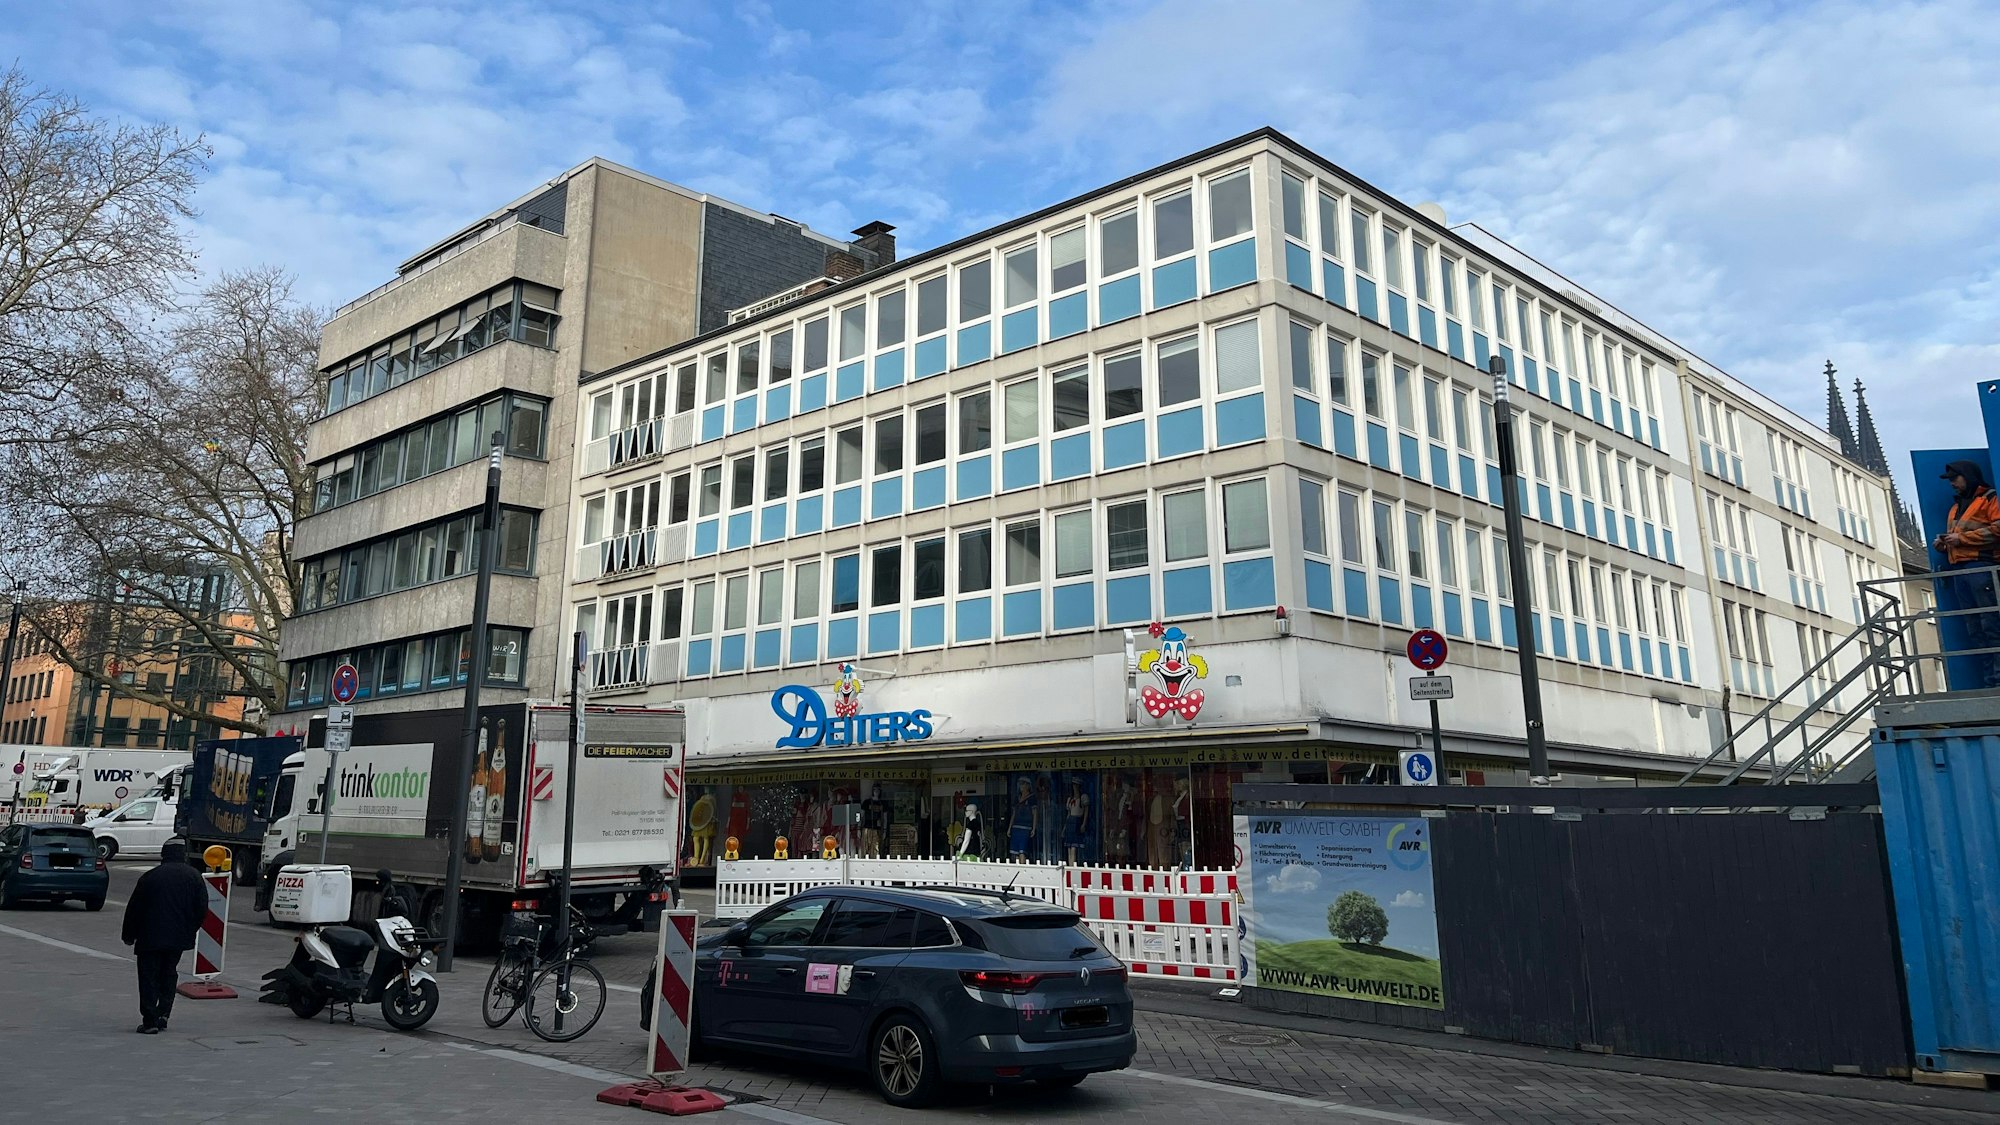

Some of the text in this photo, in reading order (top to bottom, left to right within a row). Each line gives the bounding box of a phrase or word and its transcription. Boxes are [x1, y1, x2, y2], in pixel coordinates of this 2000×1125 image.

[509, 641, 518, 655] 2
[300, 671, 307, 691] 2
[1413, 688, 1451, 696] Seitenstreifen
[587, 746, 670, 756] DIE FEIERMACHER
[1012, 756, 1127, 770] www.deiters.de
[94, 769, 134, 782] WDR
[1254, 821, 1381, 837] AVR UMWELT GMBH
[1321, 845, 1372, 854] Deponiesanierung
[1399, 840, 1421, 851] AVR
[1259, 850, 1302, 859] Flächenrecycling
[1321, 852, 1354, 861] Entsorgung
[1321, 860, 1388, 871] Grundwasserreinigung
[1260, 967, 1440, 1003] WWW.AVR-UMWELT.DE
